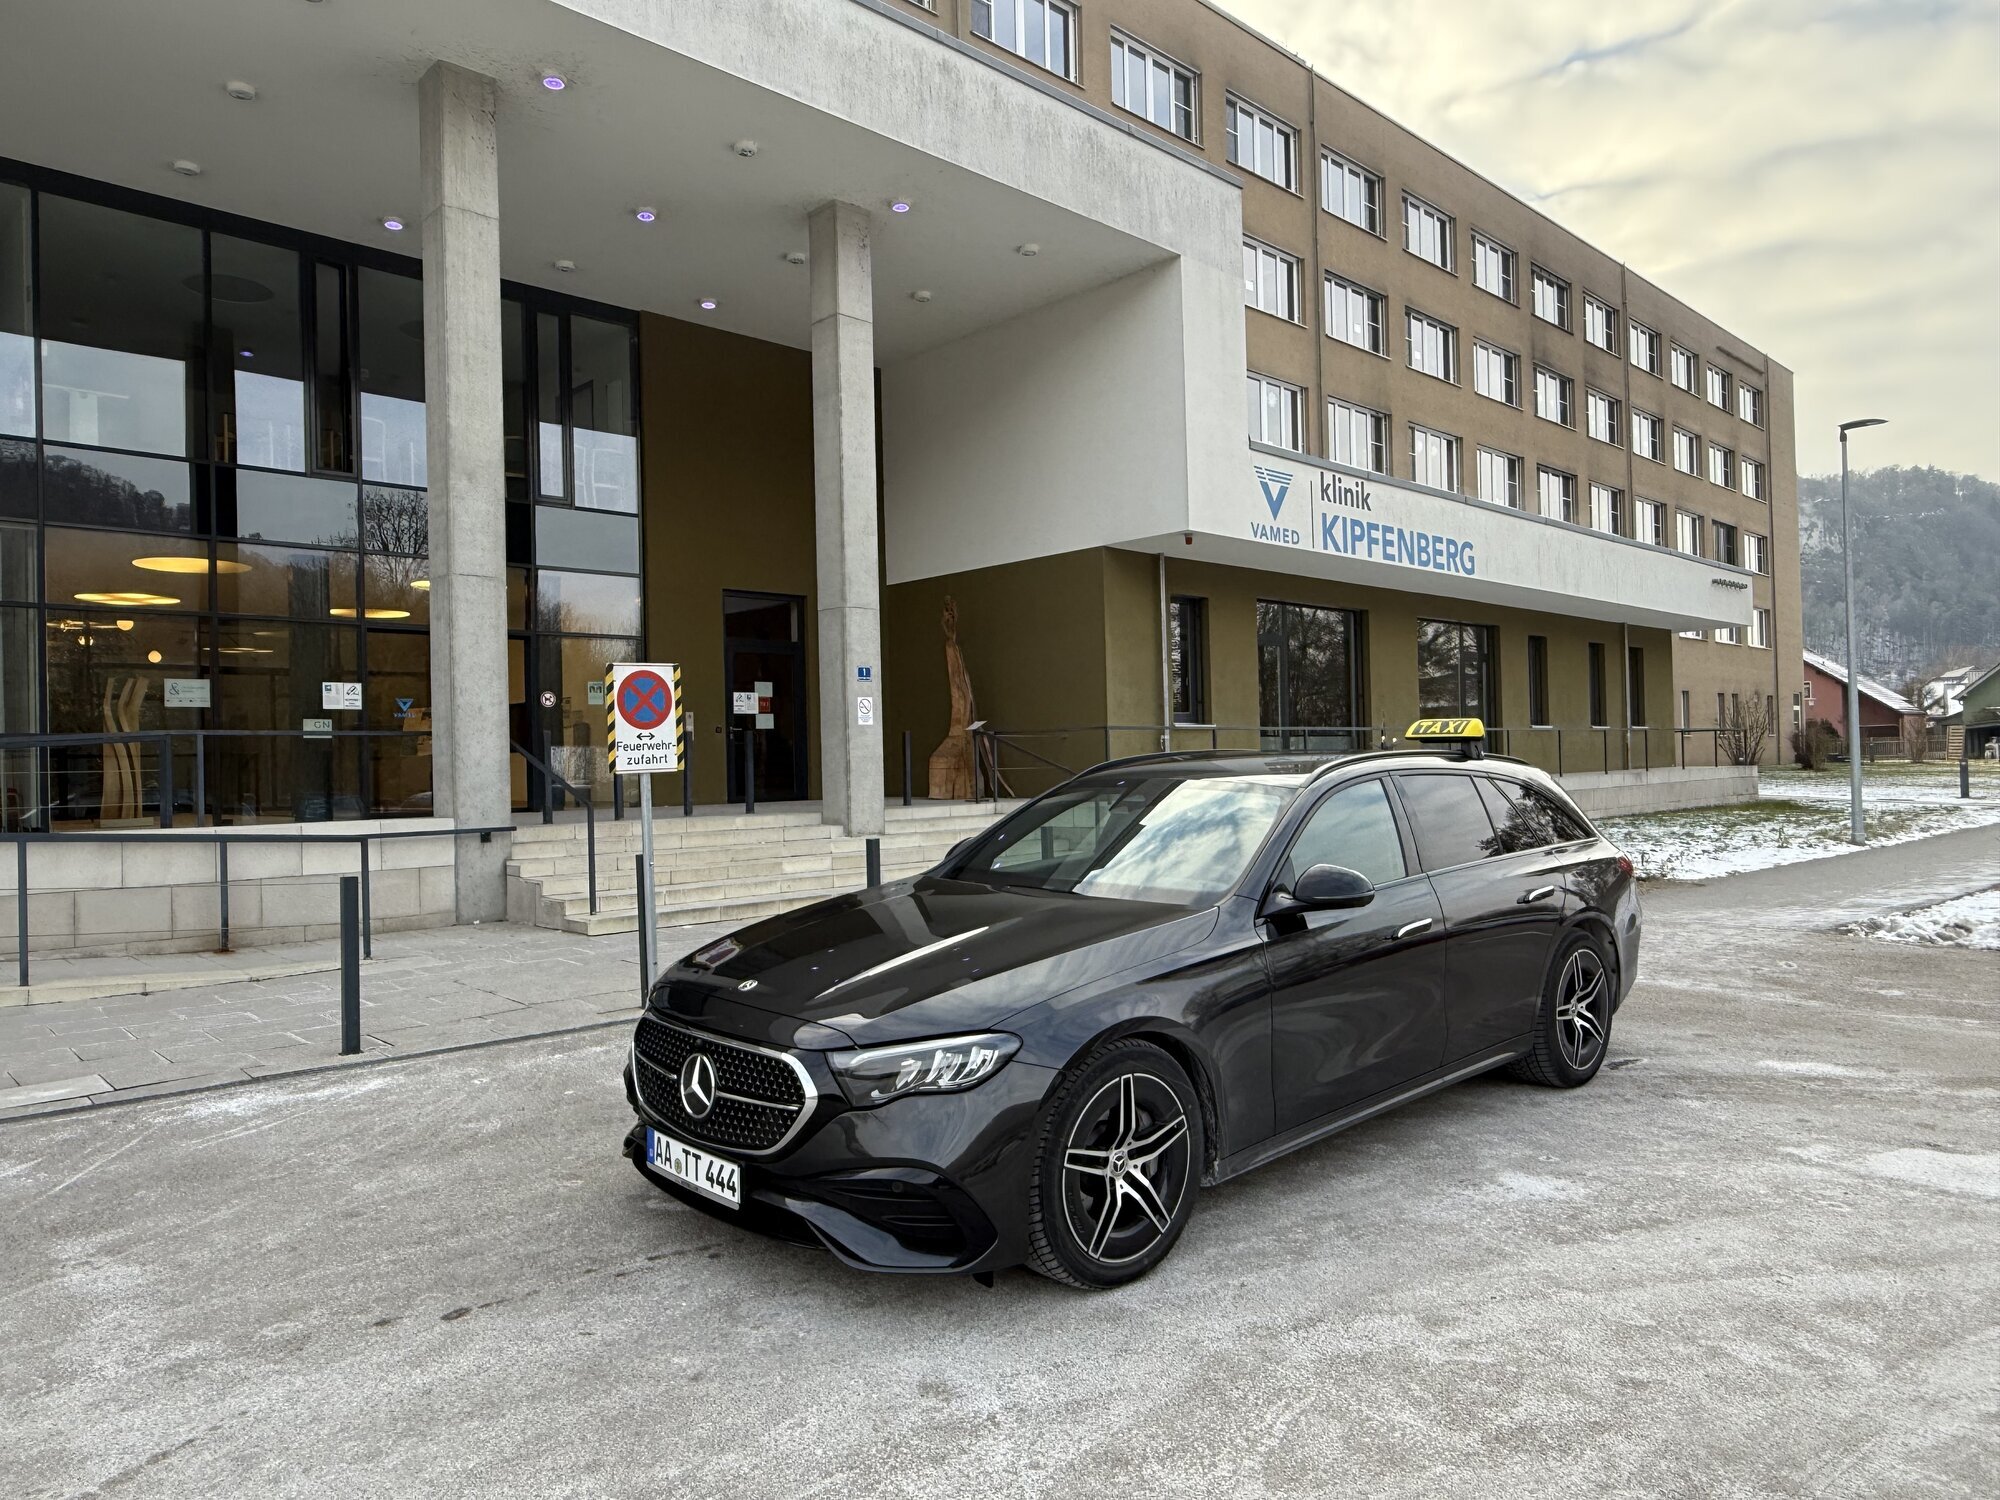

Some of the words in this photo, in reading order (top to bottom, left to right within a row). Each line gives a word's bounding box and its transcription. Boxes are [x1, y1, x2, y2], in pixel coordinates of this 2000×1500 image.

[1320, 471, 1372, 511] klinik
[1250, 521, 1300, 546] VAMED
[1321, 512, 1475, 576] KIPFENBERG
[1418, 720, 1469, 734] TAXI
[616, 740, 677, 752] Feuerwehr-
[626, 754, 668, 766] zufahrt
[655, 1136, 672, 1169] AA
[682, 1147, 702, 1182] TT
[705, 1159, 737, 1198] 444
